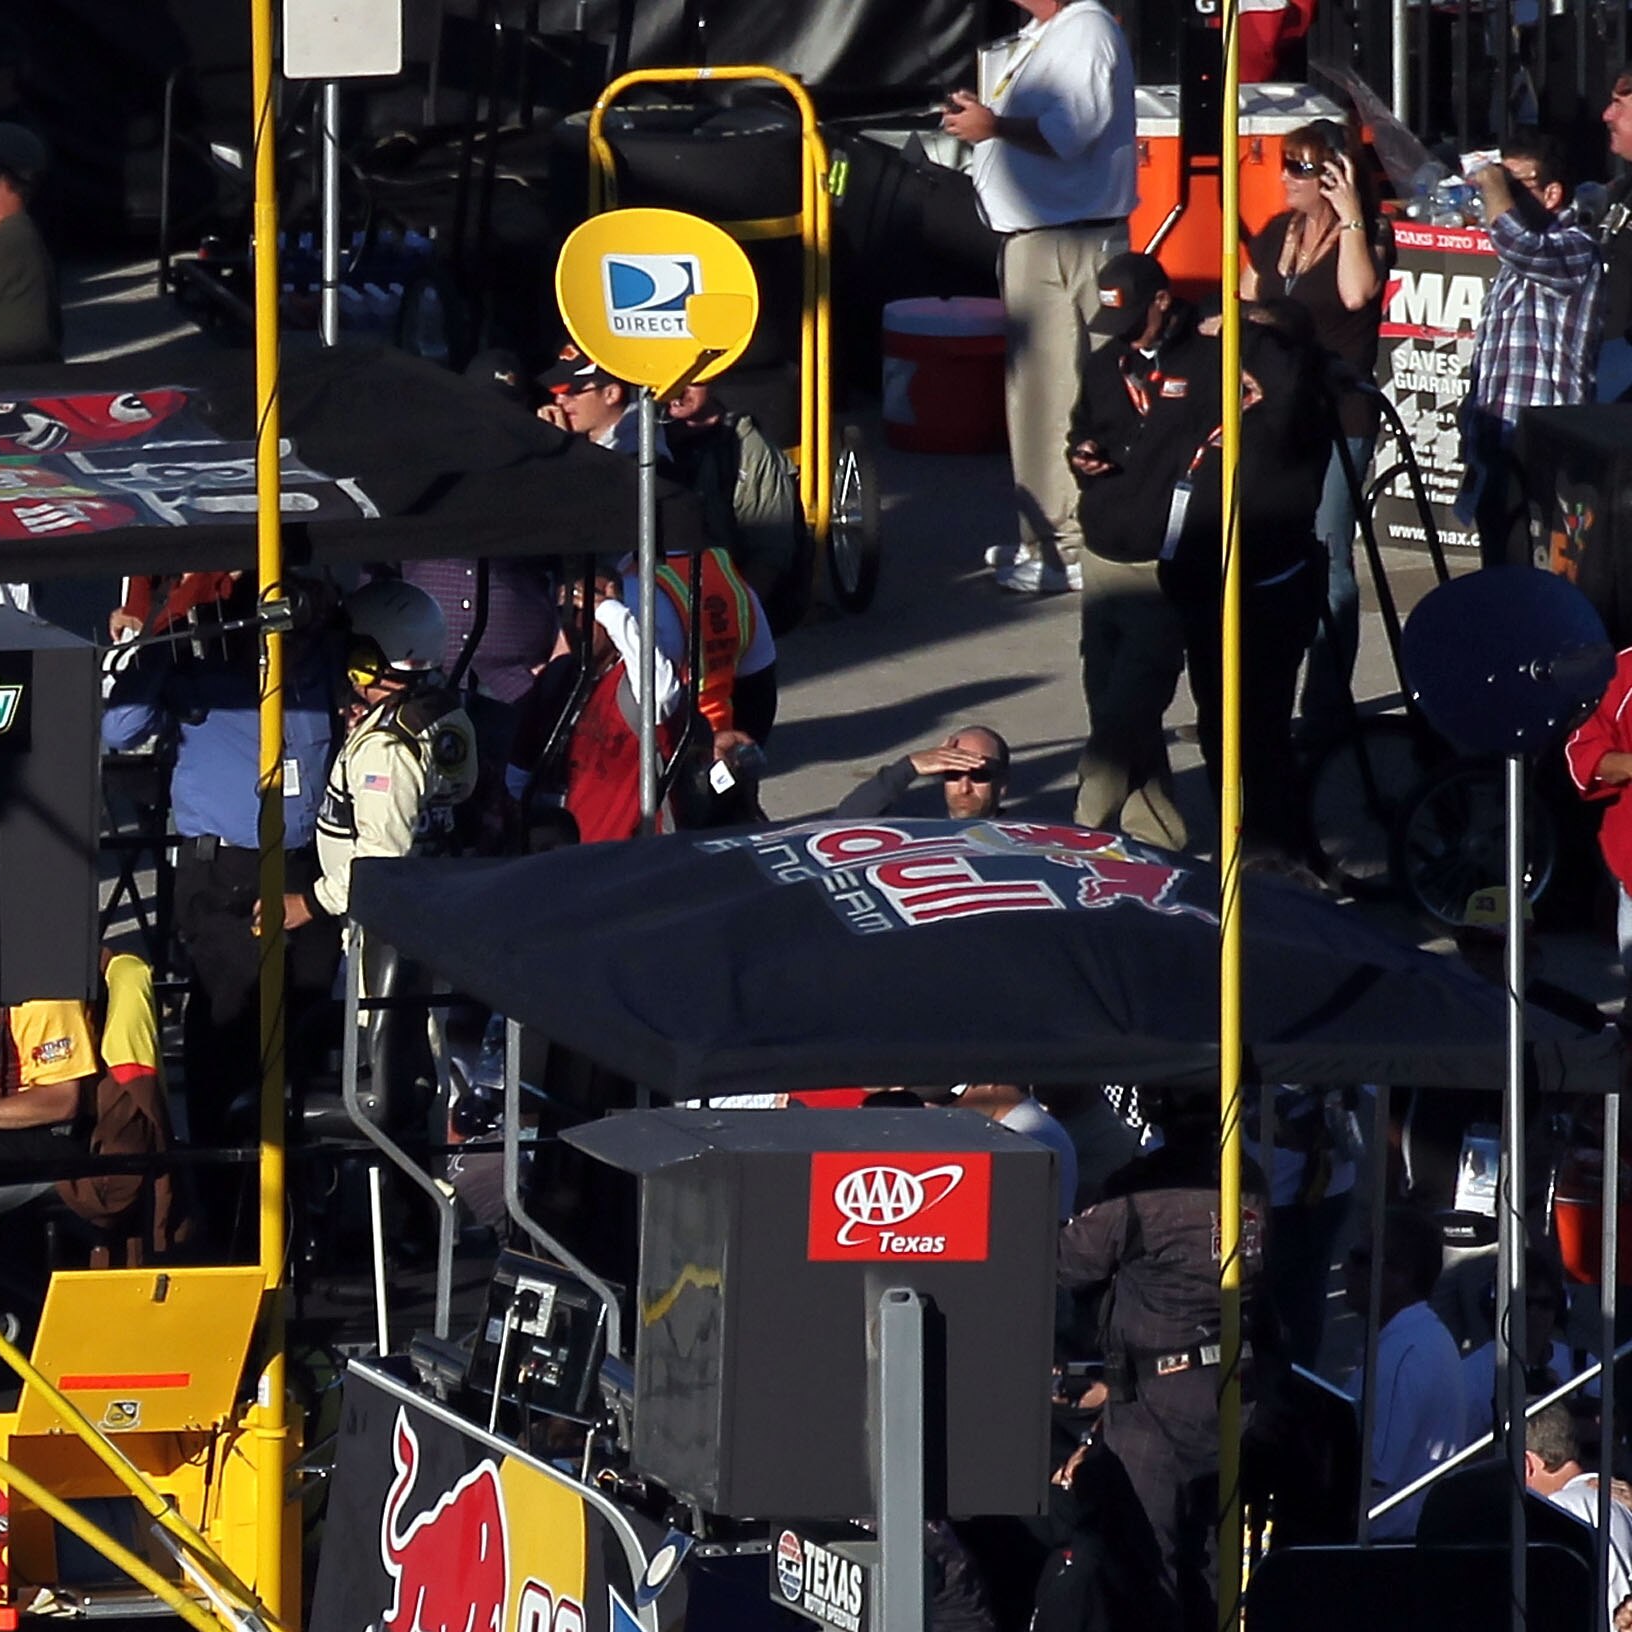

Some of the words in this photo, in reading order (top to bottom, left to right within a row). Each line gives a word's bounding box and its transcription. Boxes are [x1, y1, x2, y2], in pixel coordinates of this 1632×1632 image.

[1437, 234, 1472, 249] INTO
[614, 315, 687, 333] DIRECT
[1394, 349, 1460, 376] SAVES
[1393, 371, 1470, 396] GUARANT
[841, 1175, 918, 1223] AAA
[879, 1229, 946, 1255] Texas
[803, 1540, 863, 1615] TEXAS
